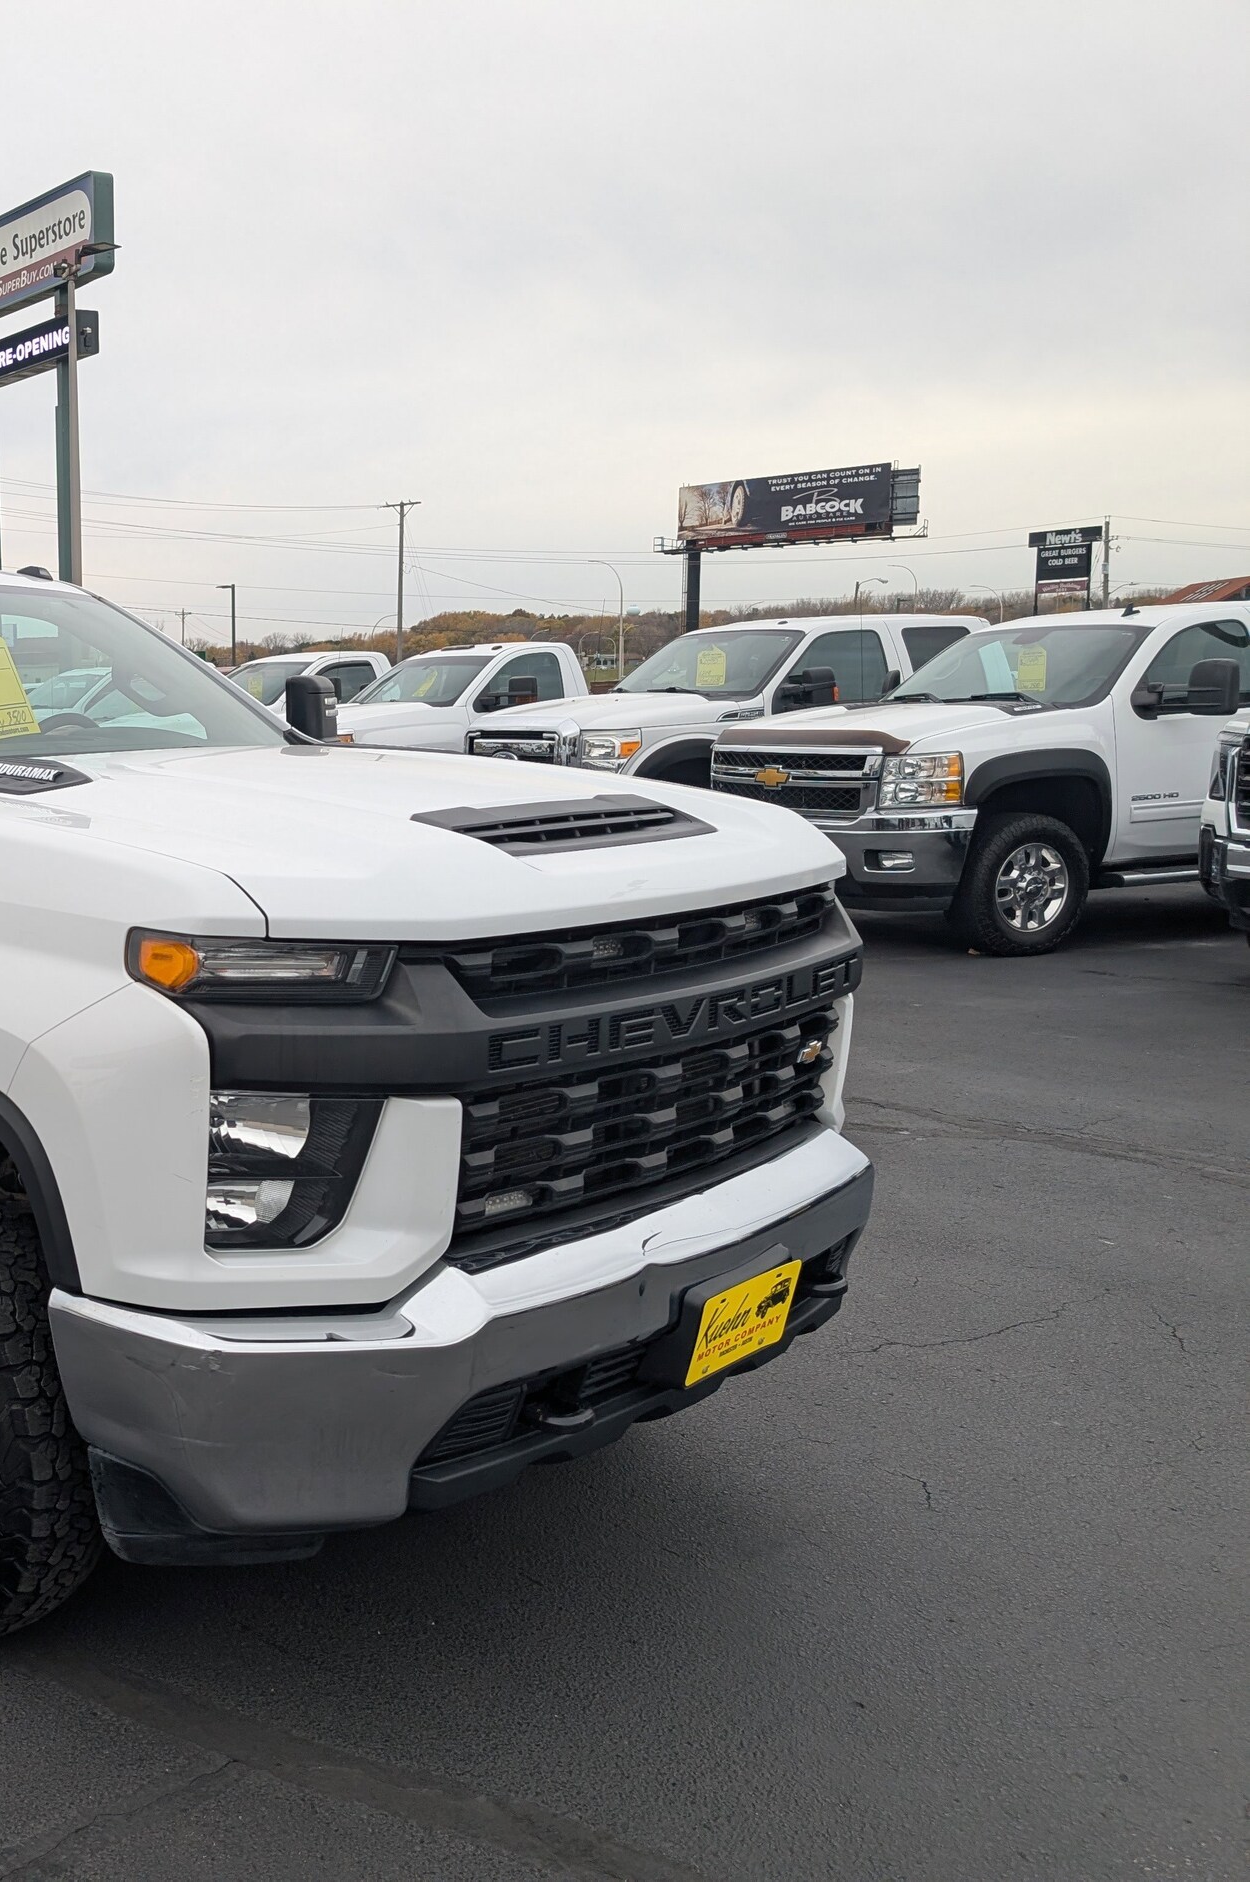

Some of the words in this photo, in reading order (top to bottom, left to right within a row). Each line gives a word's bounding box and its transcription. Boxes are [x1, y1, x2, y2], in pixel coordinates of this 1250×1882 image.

[12, 208, 86, 261] Superstore
[767, 477, 792, 485] TRUST
[829, 469, 857, 477] COUNT
[771, 484, 795, 492] EVERY
[796, 481, 827, 489] SEASON
[842, 475, 877, 483] CHANGE.
[780, 498, 864, 522] BABCOCK
[1045, 529, 1083, 545] Newt's
[1041, 550, 1059, 558] GREAT
[1060, 547, 1087, 556] BURGERS
[0, 763, 59, 781] DURAMAX
[1131, 793, 1161, 802] 2500
[1162, 791, 1180, 799] HD
[487, 951, 859, 1074] CHEVROLET
[697, 1292, 753, 1351] Kuehn
[696, 1338, 731, 1363] MOTOR
[734, 1314, 782, 1343] COMPANY
